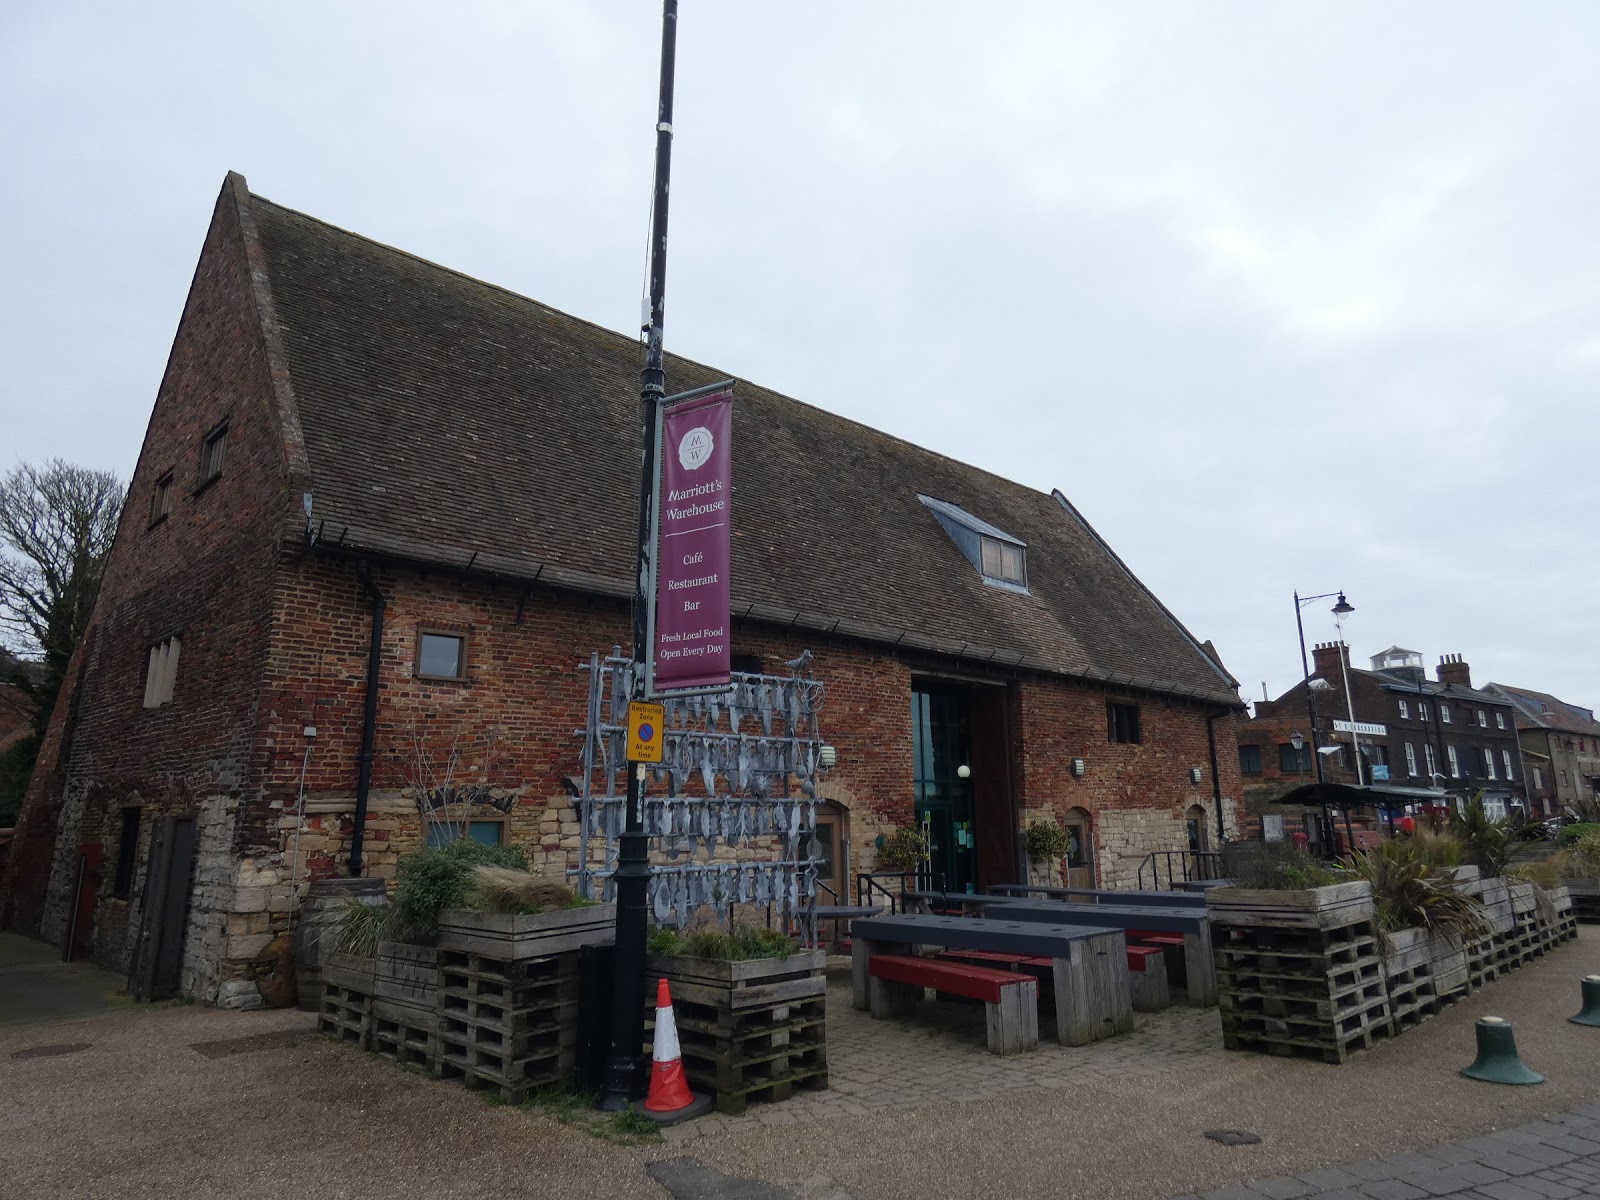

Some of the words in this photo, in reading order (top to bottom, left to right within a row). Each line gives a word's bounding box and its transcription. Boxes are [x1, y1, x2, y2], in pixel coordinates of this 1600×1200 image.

[691, 435, 702, 446] M
[690, 450, 701, 460] W
[668, 479, 722, 501] Marriott's
[666, 500, 724, 520] Warehouse
[683, 551, 703, 565] Café
[668, 573, 718, 590] Restaurant
[684, 601, 700, 612] Bar
[661, 633, 680, 643] Fresh
[682, 630, 702, 640] Local
[703, 627, 723, 638] Food
[660, 649, 681, 660] Open
[683, 646, 705, 657] Every
[707, 643, 724, 655] Day
[631, 705, 662, 714] Restricted
